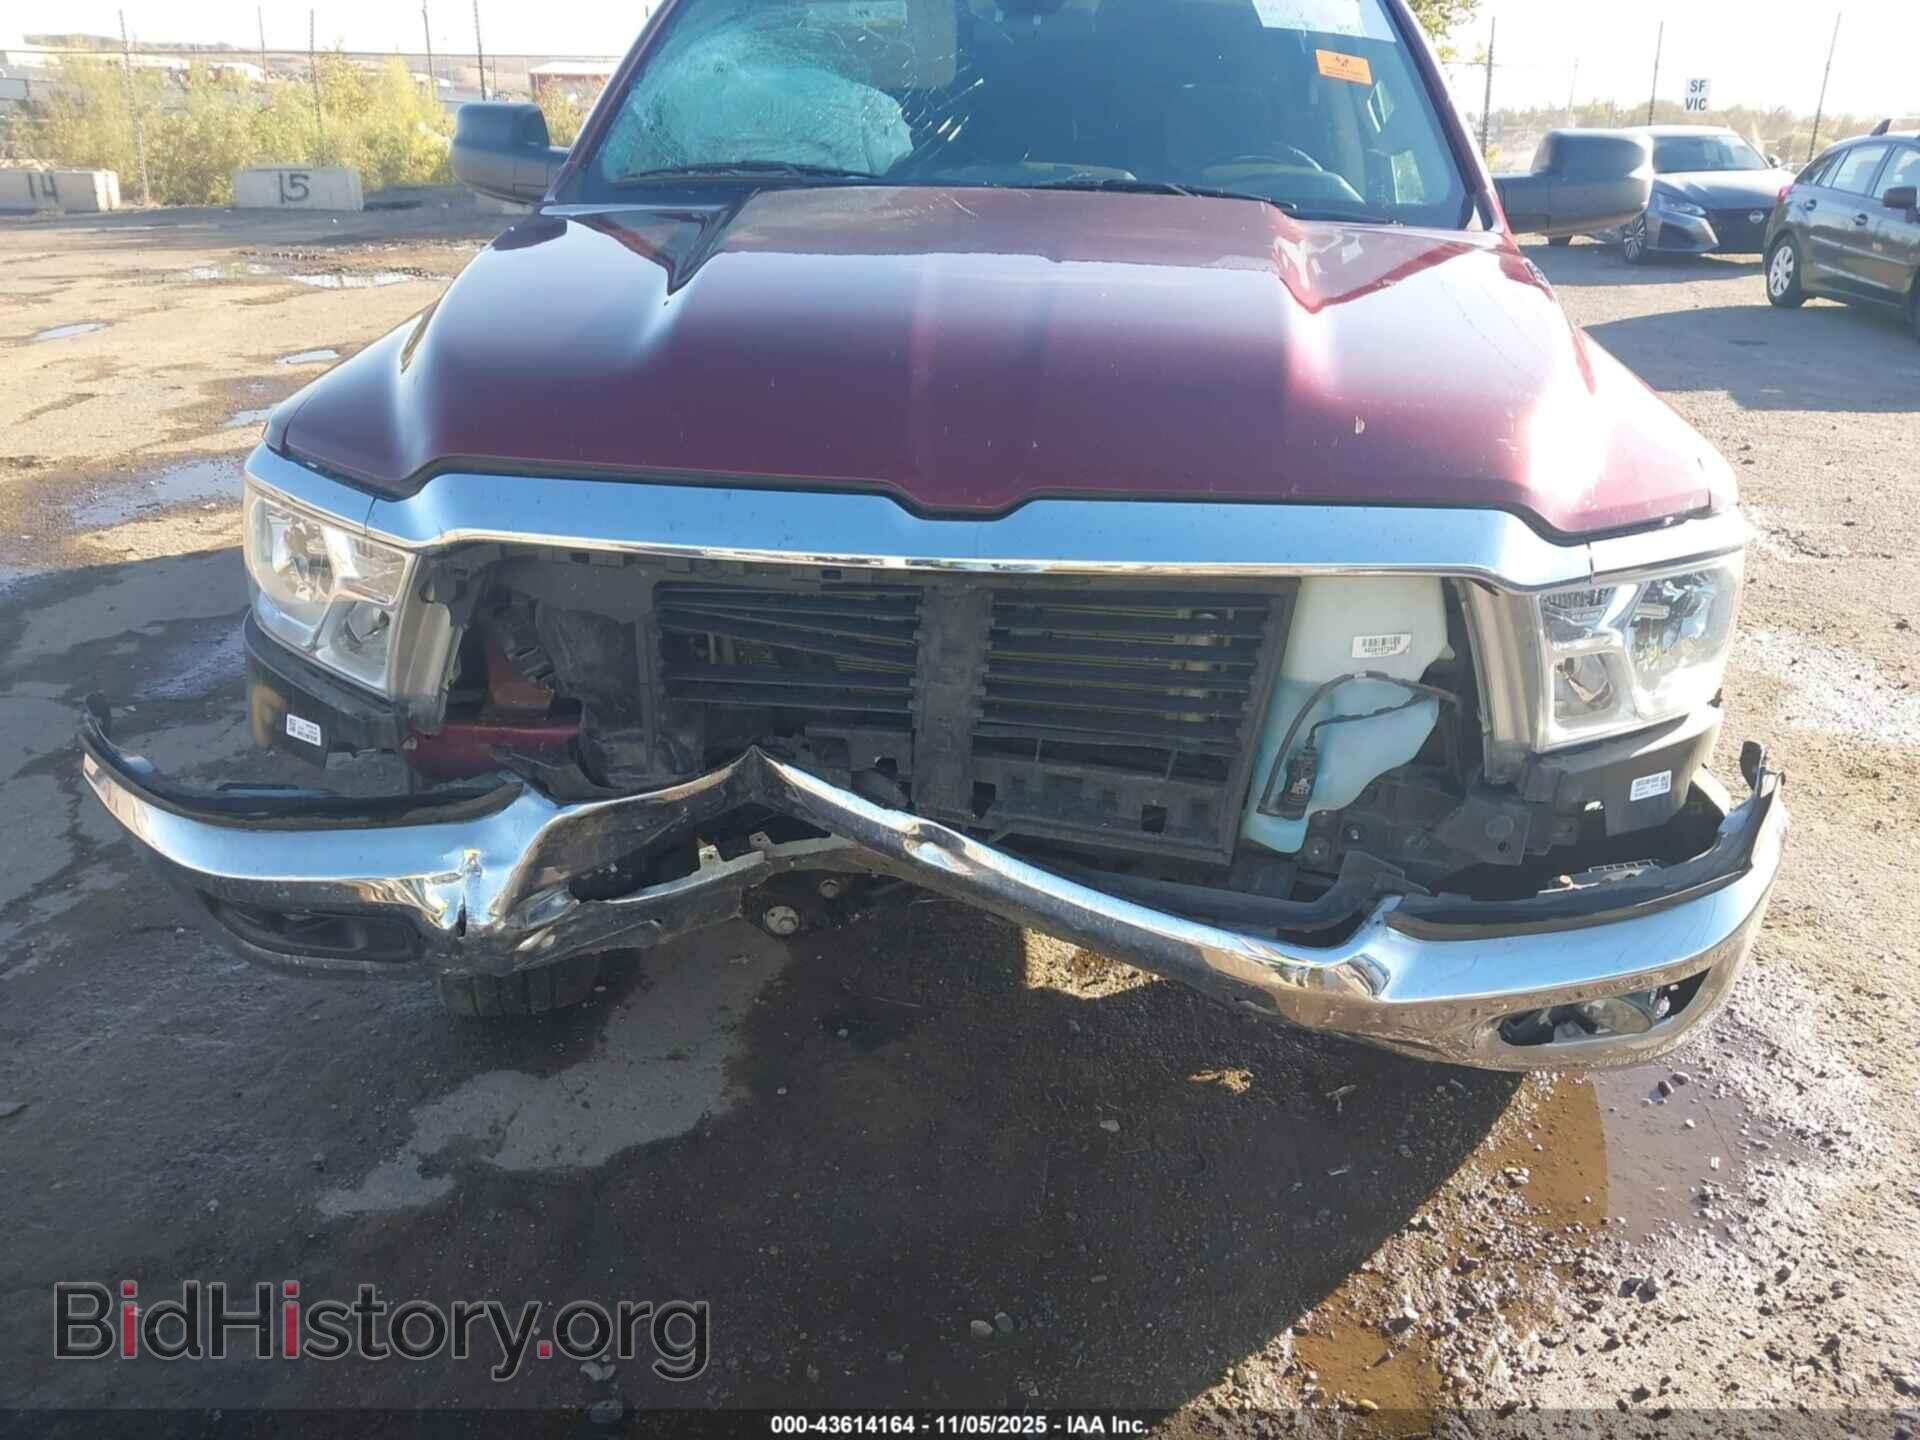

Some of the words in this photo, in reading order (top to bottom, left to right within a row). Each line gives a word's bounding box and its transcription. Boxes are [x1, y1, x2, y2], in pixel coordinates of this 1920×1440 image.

[1690, 79, 1706, 93] SF
[1685, 97, 1707, 111] VIC
[27, 172, 58, 202] 14
[278, 172, 310, 204] 15
